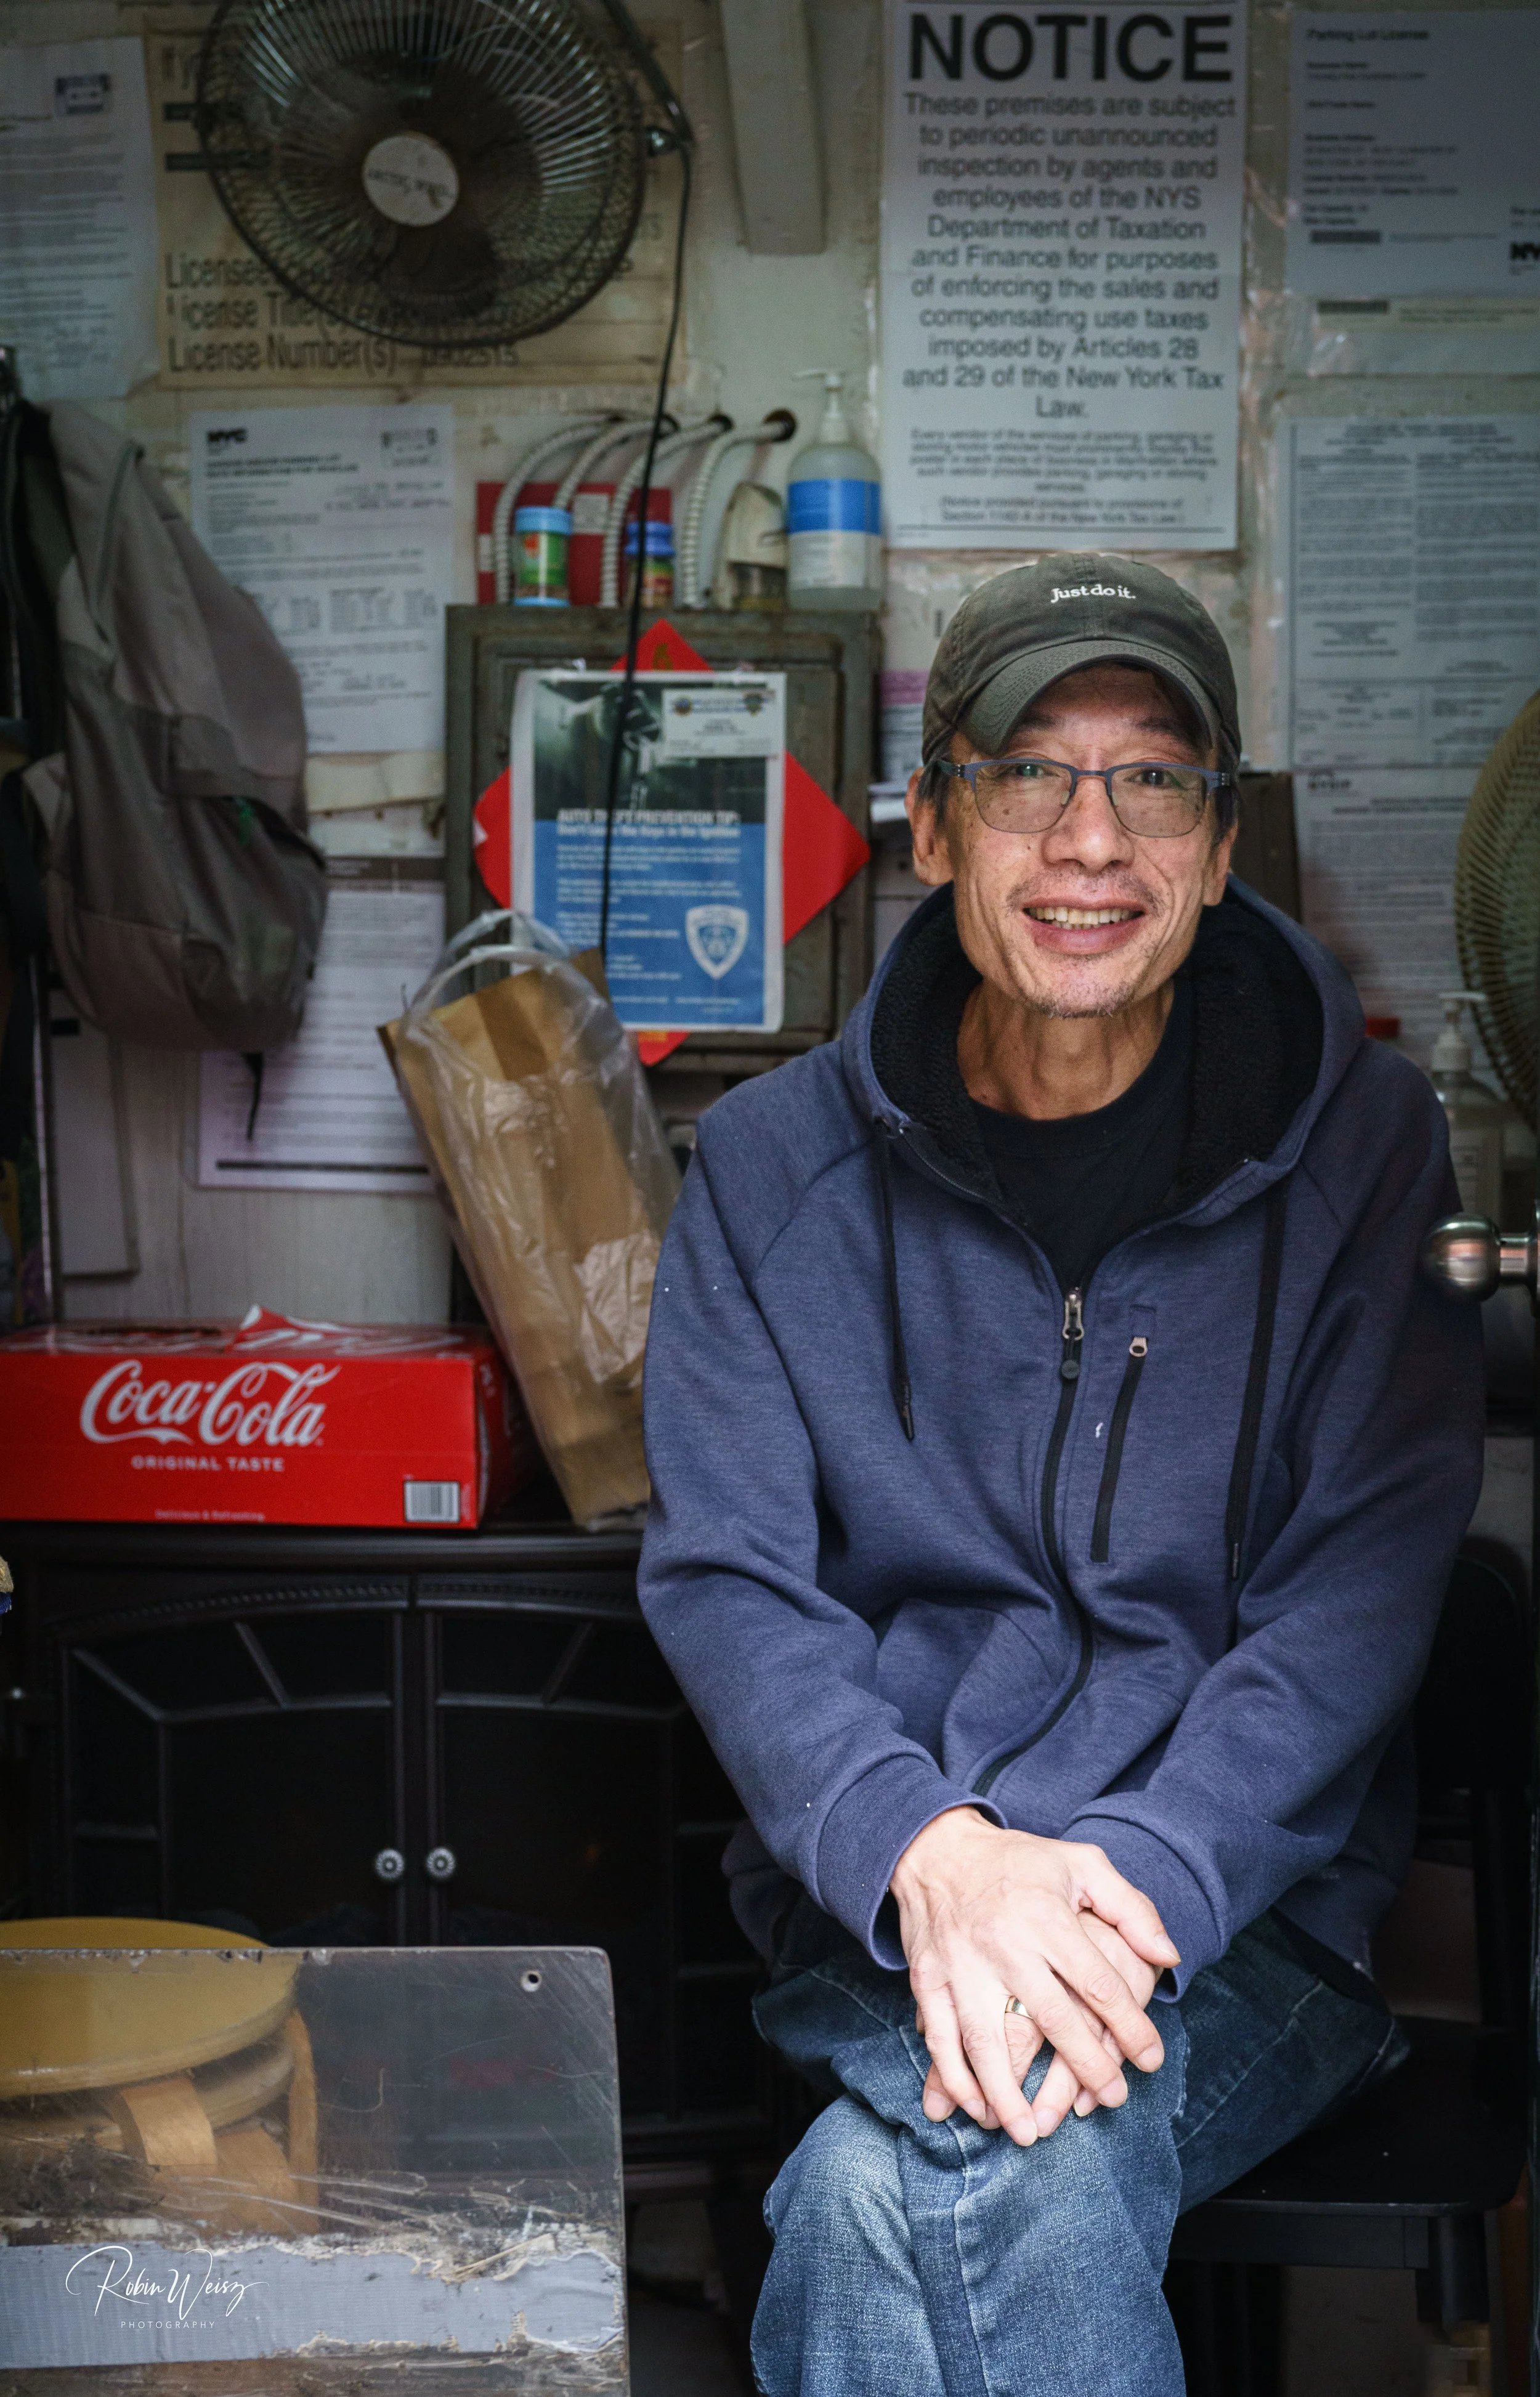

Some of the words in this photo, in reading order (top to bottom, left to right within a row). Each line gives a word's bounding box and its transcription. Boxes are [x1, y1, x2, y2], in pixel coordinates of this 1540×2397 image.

[909, 13, 1232, 82] NOTICE
[904, 92, 979, 115] These
[985, 94, 1096, 120] premises
[1101, 99, 1141, 116] are
[1148, 94, 1236, 121] subject
[920, 125, 941, 146] to
[949, 124, 1045, 153] periodic
[1052, 125, 1217, 147] unannounced
[918, 155, 1040, 181] inspection
[1047, 155, 1076, 182] by
[1081, 158, 1164, 182] agents
[1172, 156, 1218, 179] and
[933, 187, 1062, 214] employees
[1069, 186, 1093, 209] of
[1101, 187, 1137, 209] the
[1145, 186, 1201, 210] NYS
[928, 215, 1069, 241] Department
[1076, 215, 1099, 238] of
[1107, 216, 1206, 240] Taxation
[912, 246, 958, 267] and
[965, 246, 1060, 268] Finance
[1067, 246, 1098, 268] for
[1106, 249, 1218, 272] purposes
[912, 277, 937, 297] of
[941, 277, 1052, 304] enforcing
[1058, 277, 1096, 299] the
[1103, 277, 1165, 299] sales
[1173, 277, 1219, 299] and
[919, 309, 1087, 333] compensating
[1094, 310, 1138, 330] use
[1145, 310, 1209, 331] taxes
[167, 336, 261, 371] License
[267, 333, 395, 377] Number(s)
[928, 336, 1030, 360] imposed
[1037, 336, 1066, 362] by
[1071, 336, 1161, 359] Articles
[1168, 338, 1199, 360] 28
[902, 368, 947, 388] and
[954, 365, 985, 388] 29
[991, 368, 1016, 388] of
[1021, 368, 1058, 388] the
[1066, 368, 1119, 389] New
[1124, 367, 1177, 389] York
[1183, 366, 1223, 390] Tax
[1035, 397, 1088, 418] Law.
[1051, 586, 1089, 603] Just
[1090, 584, 1116, 596] do
[79, 1360, 341, 1445] Coca-Cola
[131, 1455, 222, 1472] ORIGINAL
[228, 1456, 284, 1472] TASTE
